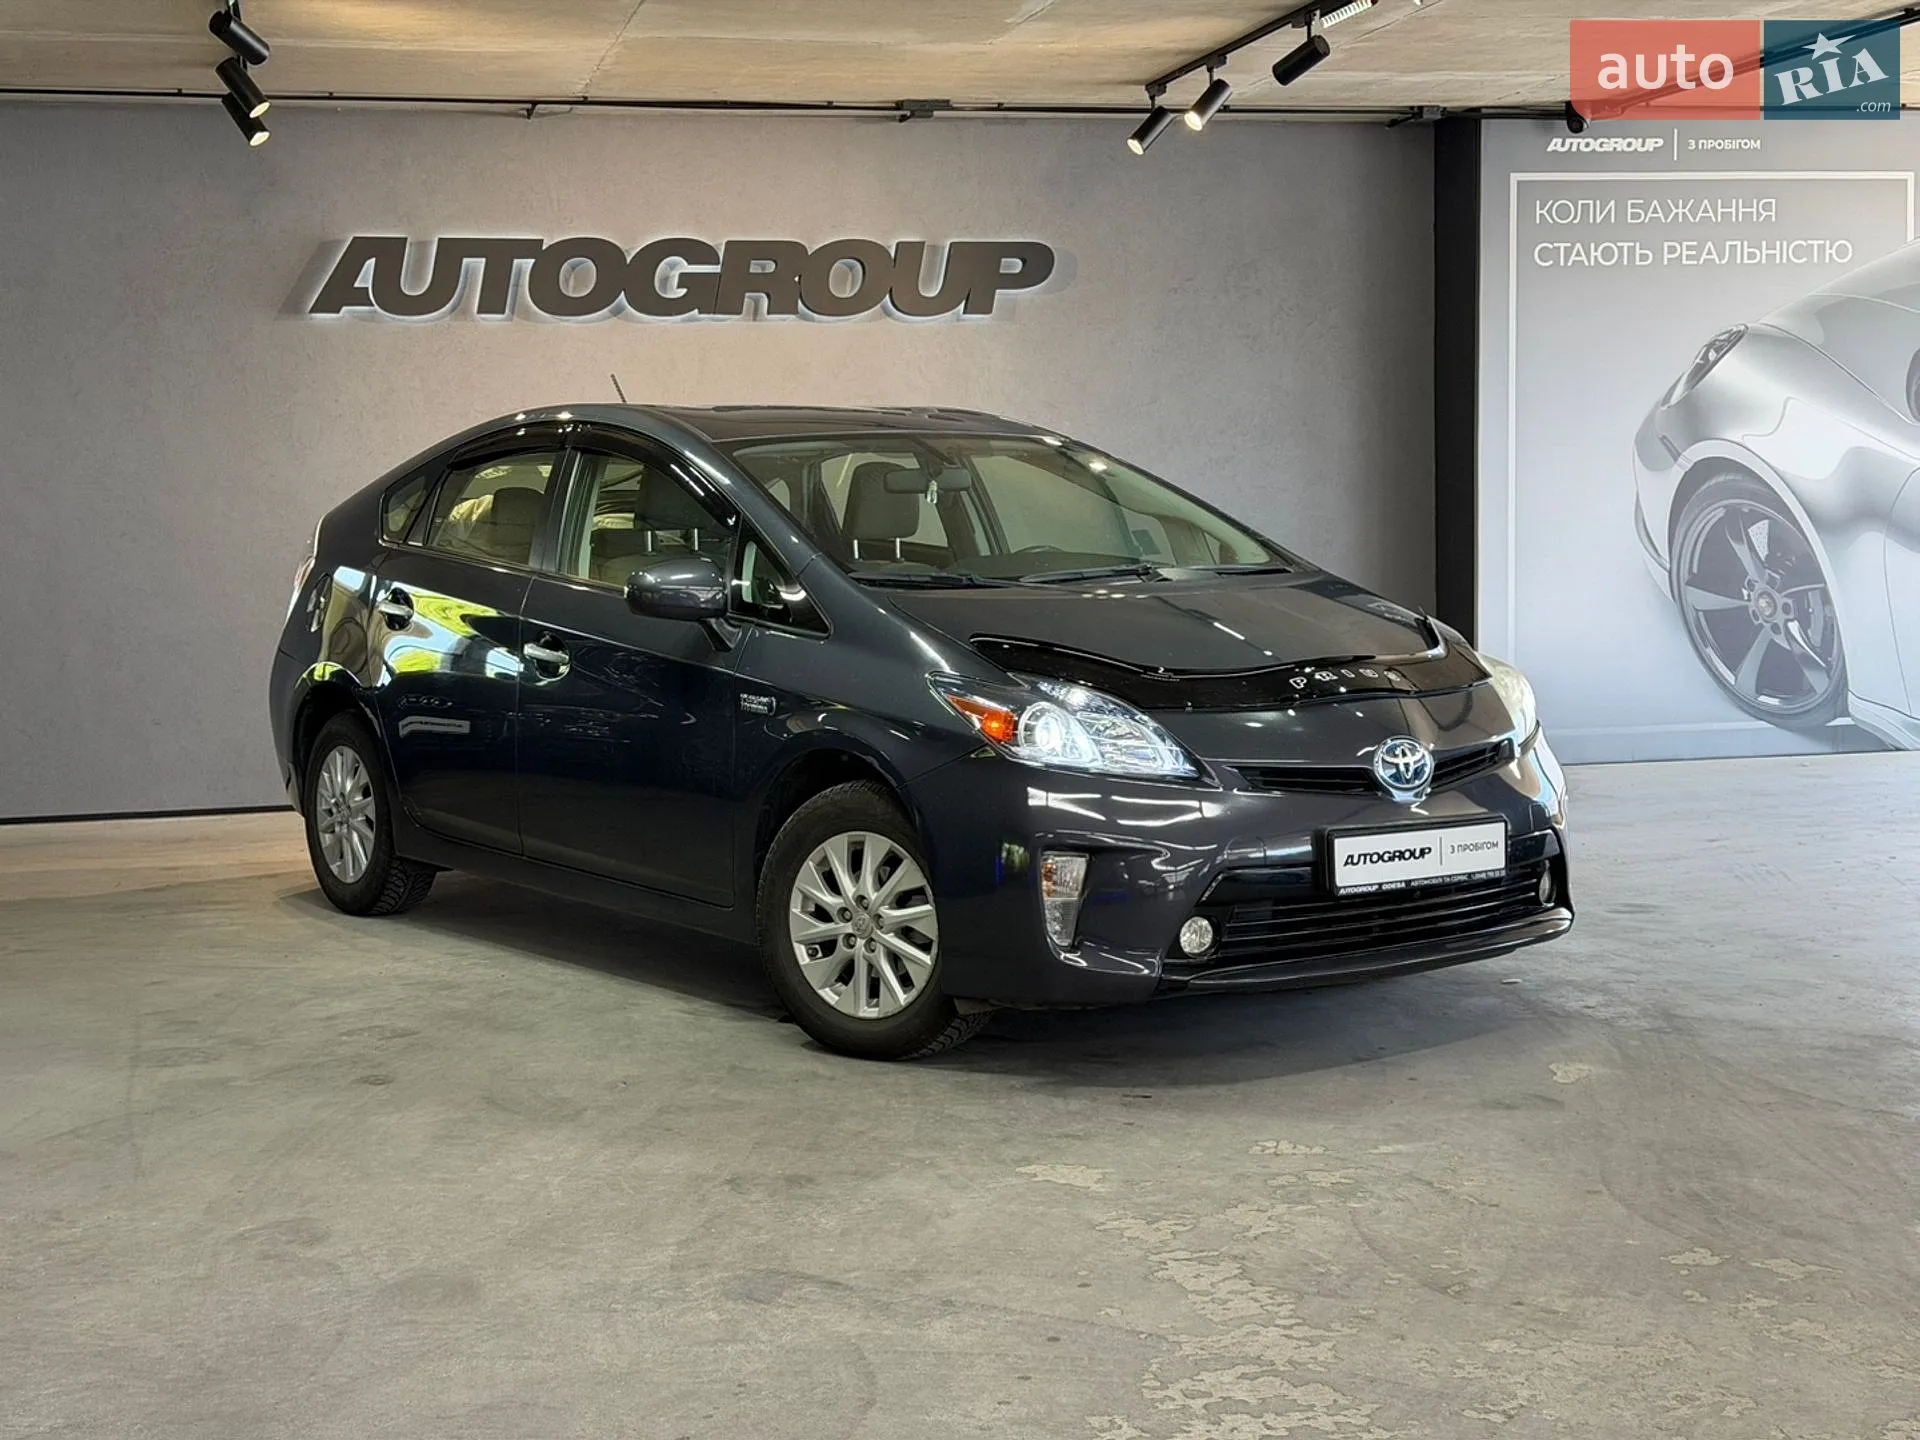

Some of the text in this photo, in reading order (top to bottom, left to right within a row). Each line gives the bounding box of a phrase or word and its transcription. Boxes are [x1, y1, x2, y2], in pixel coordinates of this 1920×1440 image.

[1547, 138, 1664, 152] AUTOGROUP
[1699, 138, 1761, 150] ПРОБІГОМ
[1535, 199, 1776, 224] КОЛИ БАЖАННЯ
[1534, 239, 1853, 267] СТАЮТЬ РЕАЛЬНІСТЮ
[309, 236, 1055, 323] AUTOGROUP
[1457, 840, 1499, 853] ПРОБІГОМ
[1343, 847, 1432, 867] AUTOGROUP
